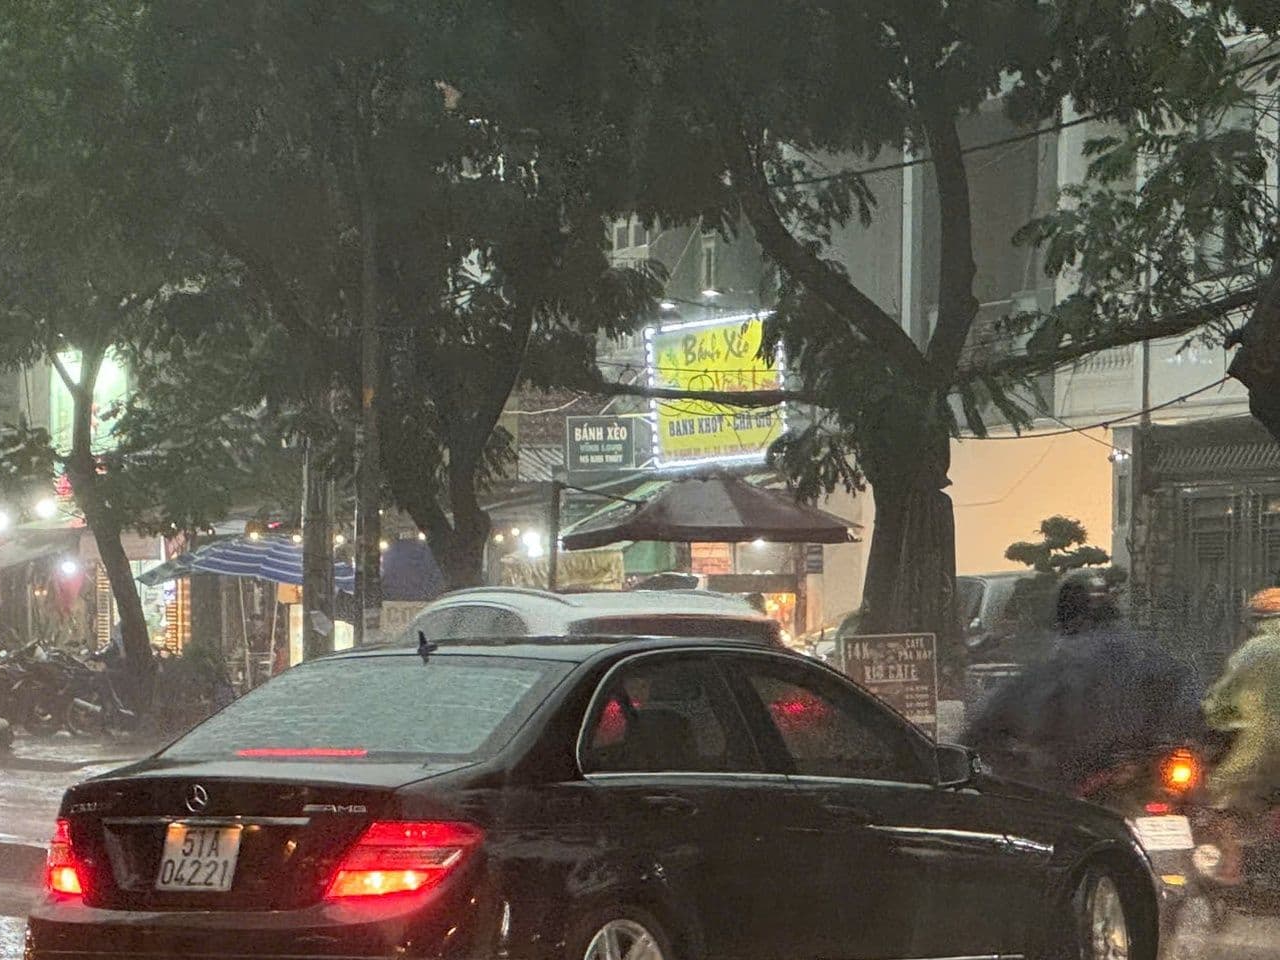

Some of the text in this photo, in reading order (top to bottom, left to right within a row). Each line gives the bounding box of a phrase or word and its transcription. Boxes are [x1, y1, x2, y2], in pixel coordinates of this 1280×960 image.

[574, 422, 627, 441] BÁNH XÈO
[323, 804, 367, 813] AMG
[182, 829, 220, 857] 51A
[161, 859, 229, 887] 04221
